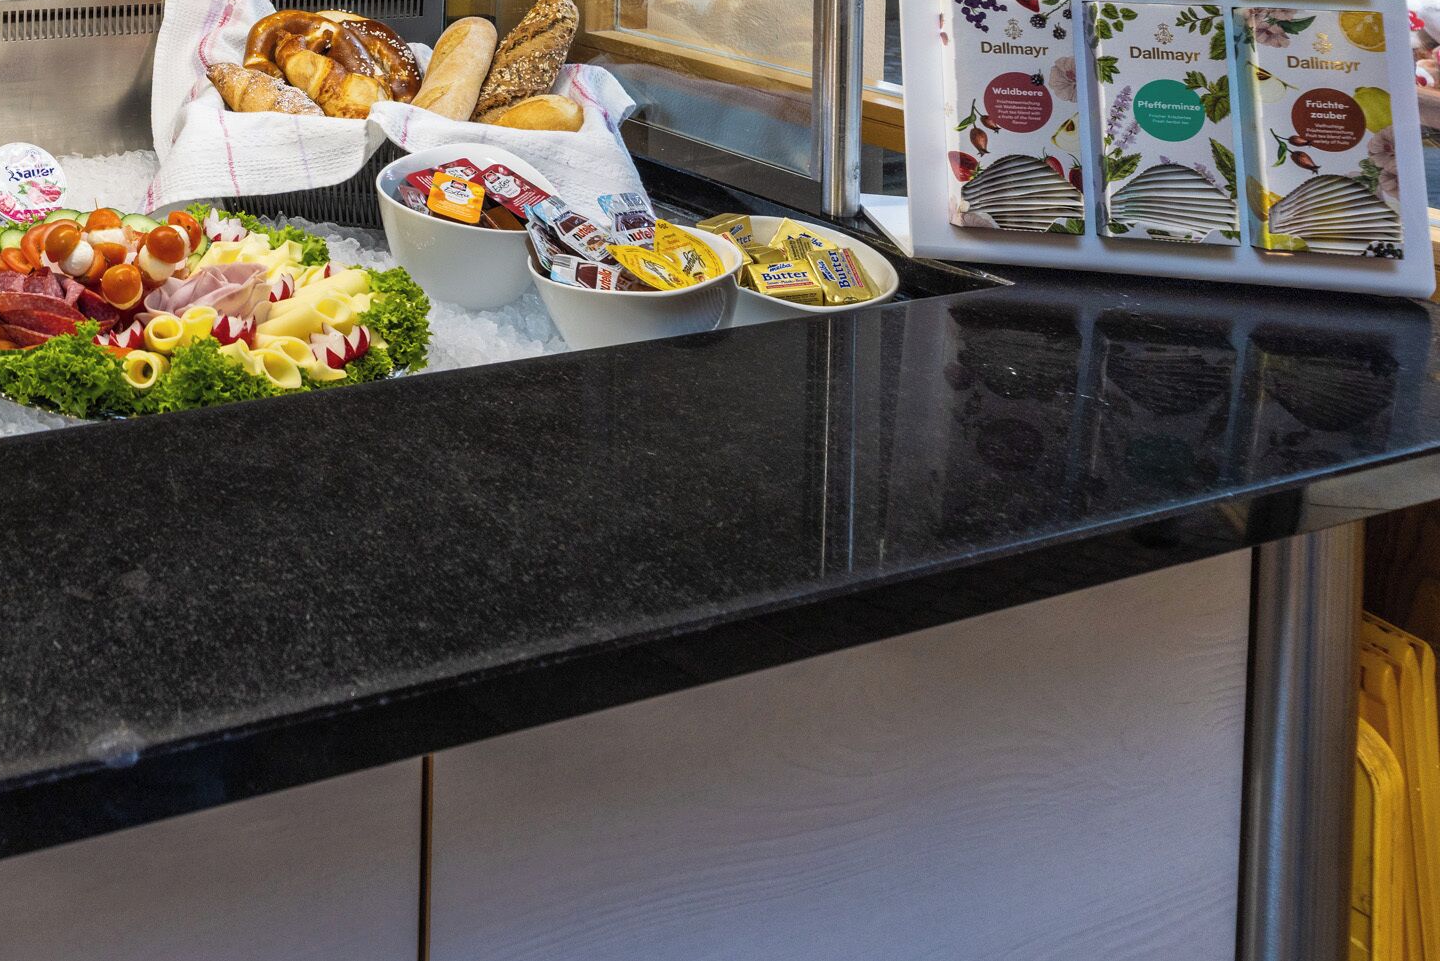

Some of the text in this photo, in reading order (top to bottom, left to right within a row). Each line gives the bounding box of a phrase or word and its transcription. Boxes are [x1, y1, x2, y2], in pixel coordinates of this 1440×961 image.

[981, 41, 1049, 58] Dallmayr
[1129, 46, 1201, 64] Dallmayr
[1287, 55, 1361, 74] Dallmayr
[992, 87, 1043, 97] Waldbeere
[1137, 100, 1201, 111] Pfefferminze
[1305, 100, 1349, 110] Früchte-
[1310, 111, 1347, 120] zauber
[572, 223, 598, 241] nutella
[627, 227, 655, 242] nutell
[736, 234, 752, 245] tter
[761, 270, 808, 281] Butter
[828, 250, 851, 289] Butter
[600, 269, 612, 290] utella
